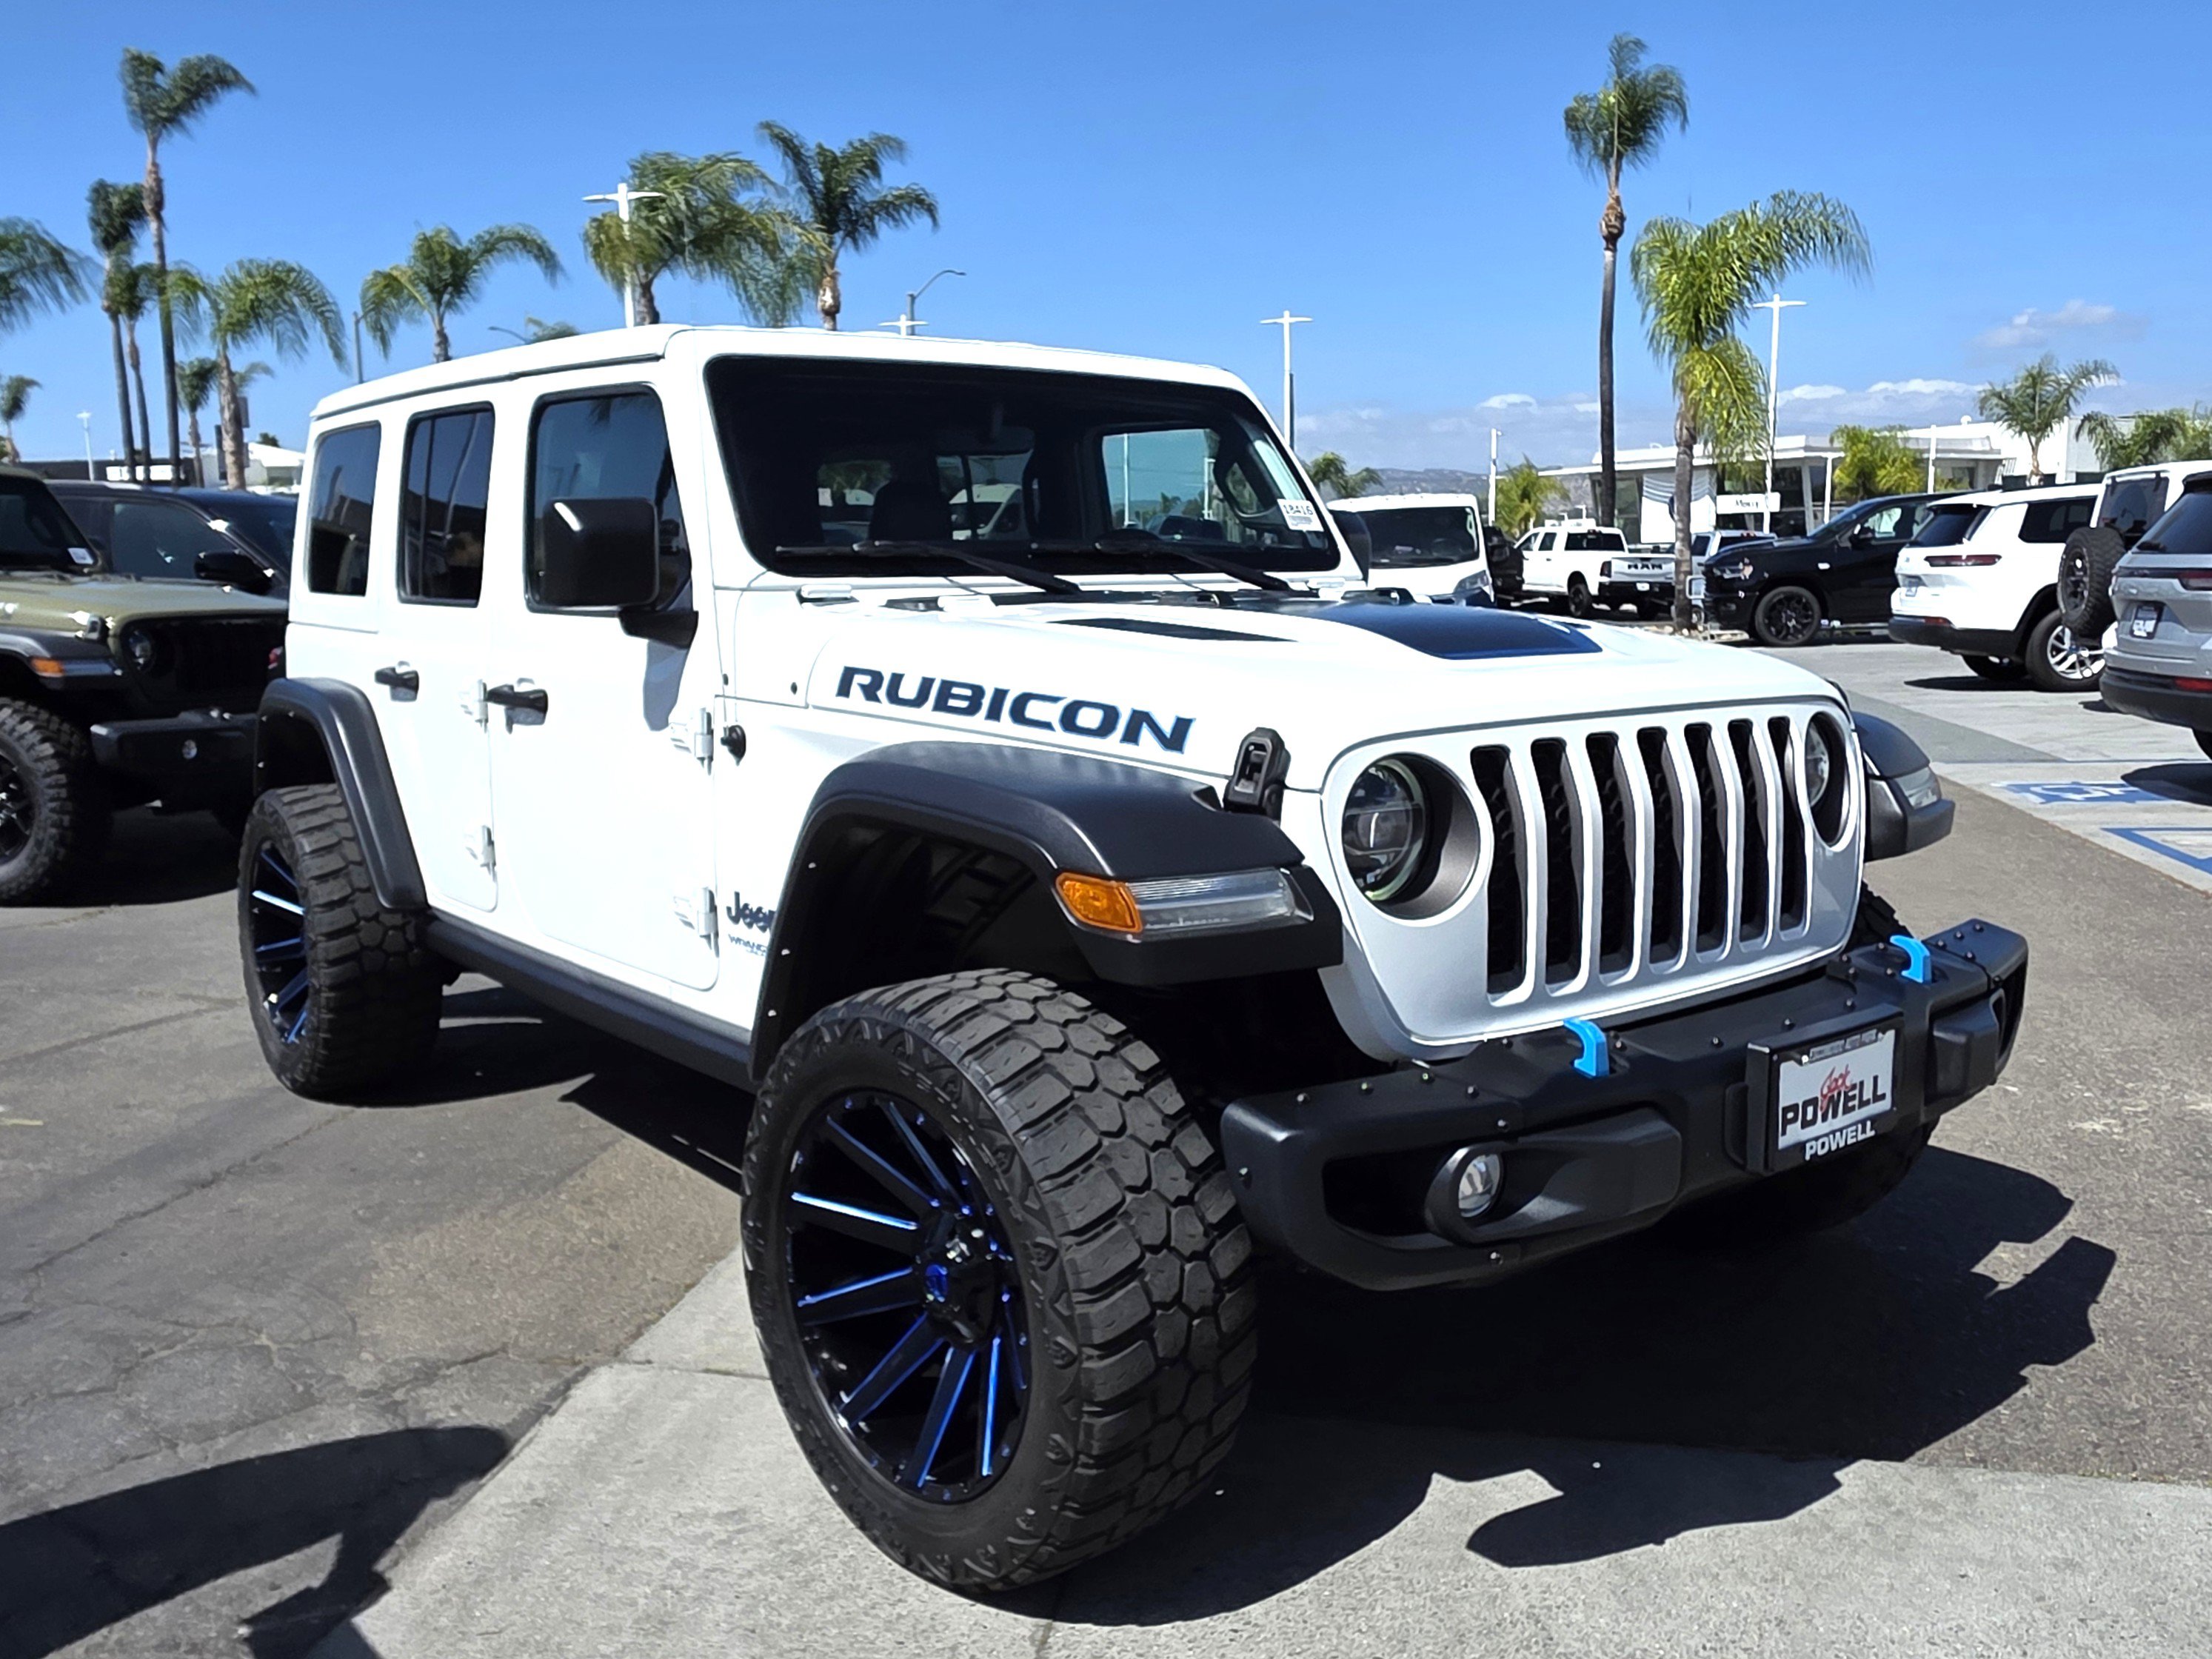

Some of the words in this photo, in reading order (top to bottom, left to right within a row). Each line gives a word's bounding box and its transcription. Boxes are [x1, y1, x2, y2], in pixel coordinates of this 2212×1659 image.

[835, 665, 1197, 755] RUBICON
[1780, 1074, 1887, 1138] POWELL
[1805, 1119, 1877, 1161] POWELL
